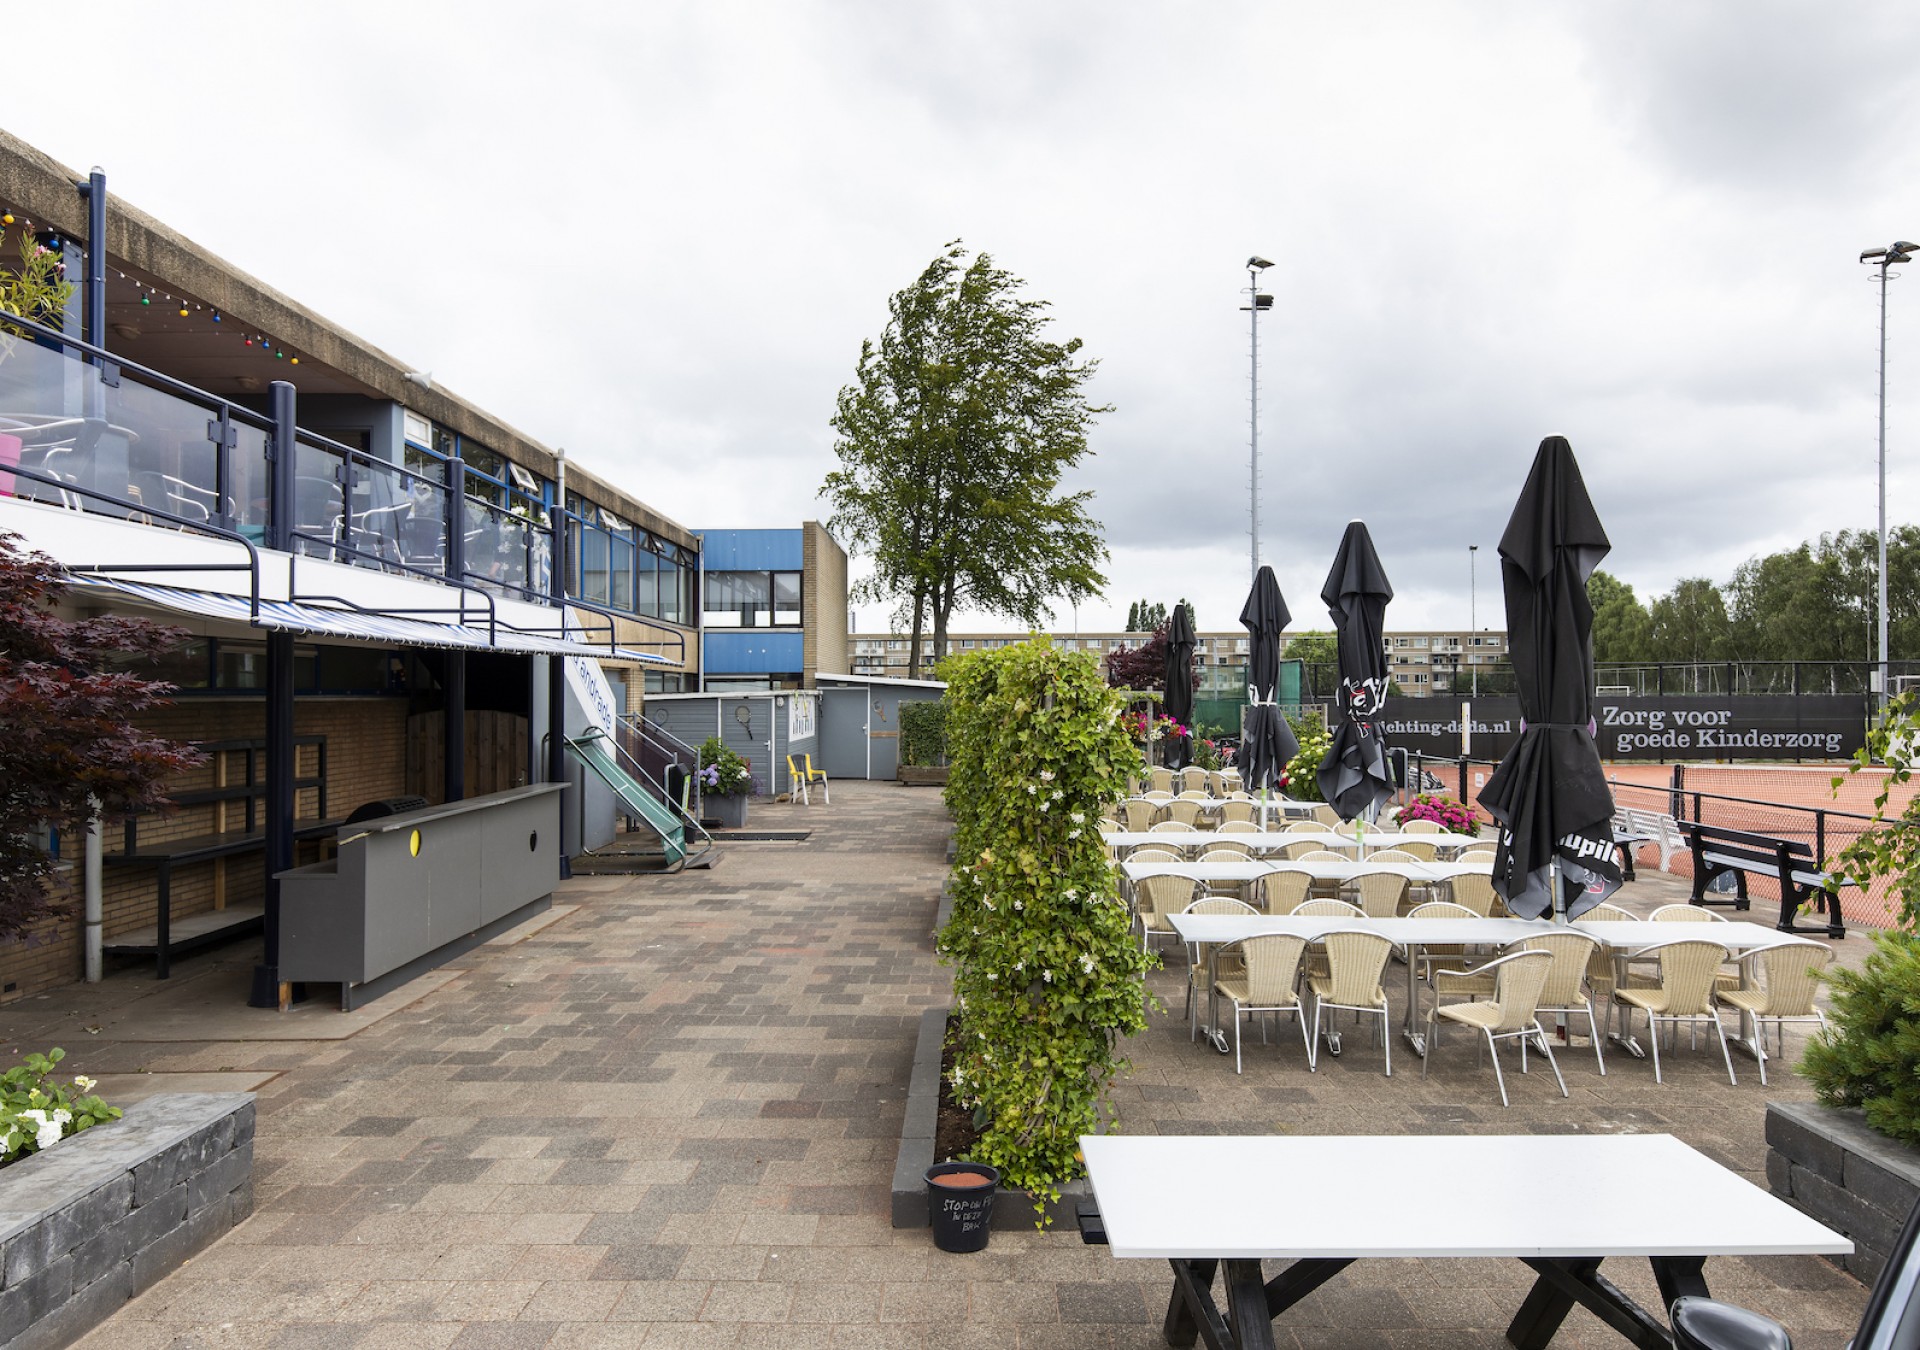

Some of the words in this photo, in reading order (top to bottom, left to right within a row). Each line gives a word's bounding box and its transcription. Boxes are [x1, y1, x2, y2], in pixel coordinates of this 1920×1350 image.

[580, 661, 611, 730] andrade
[1602, 706, 1666, 731] Zorg
[1672, 710, 1732, 726] voor
[1617, 729, 1691, 753] goede
[1695, 729, 1843, 753] Kinderzorg
[943, 1199, 970, 1211] STOP
